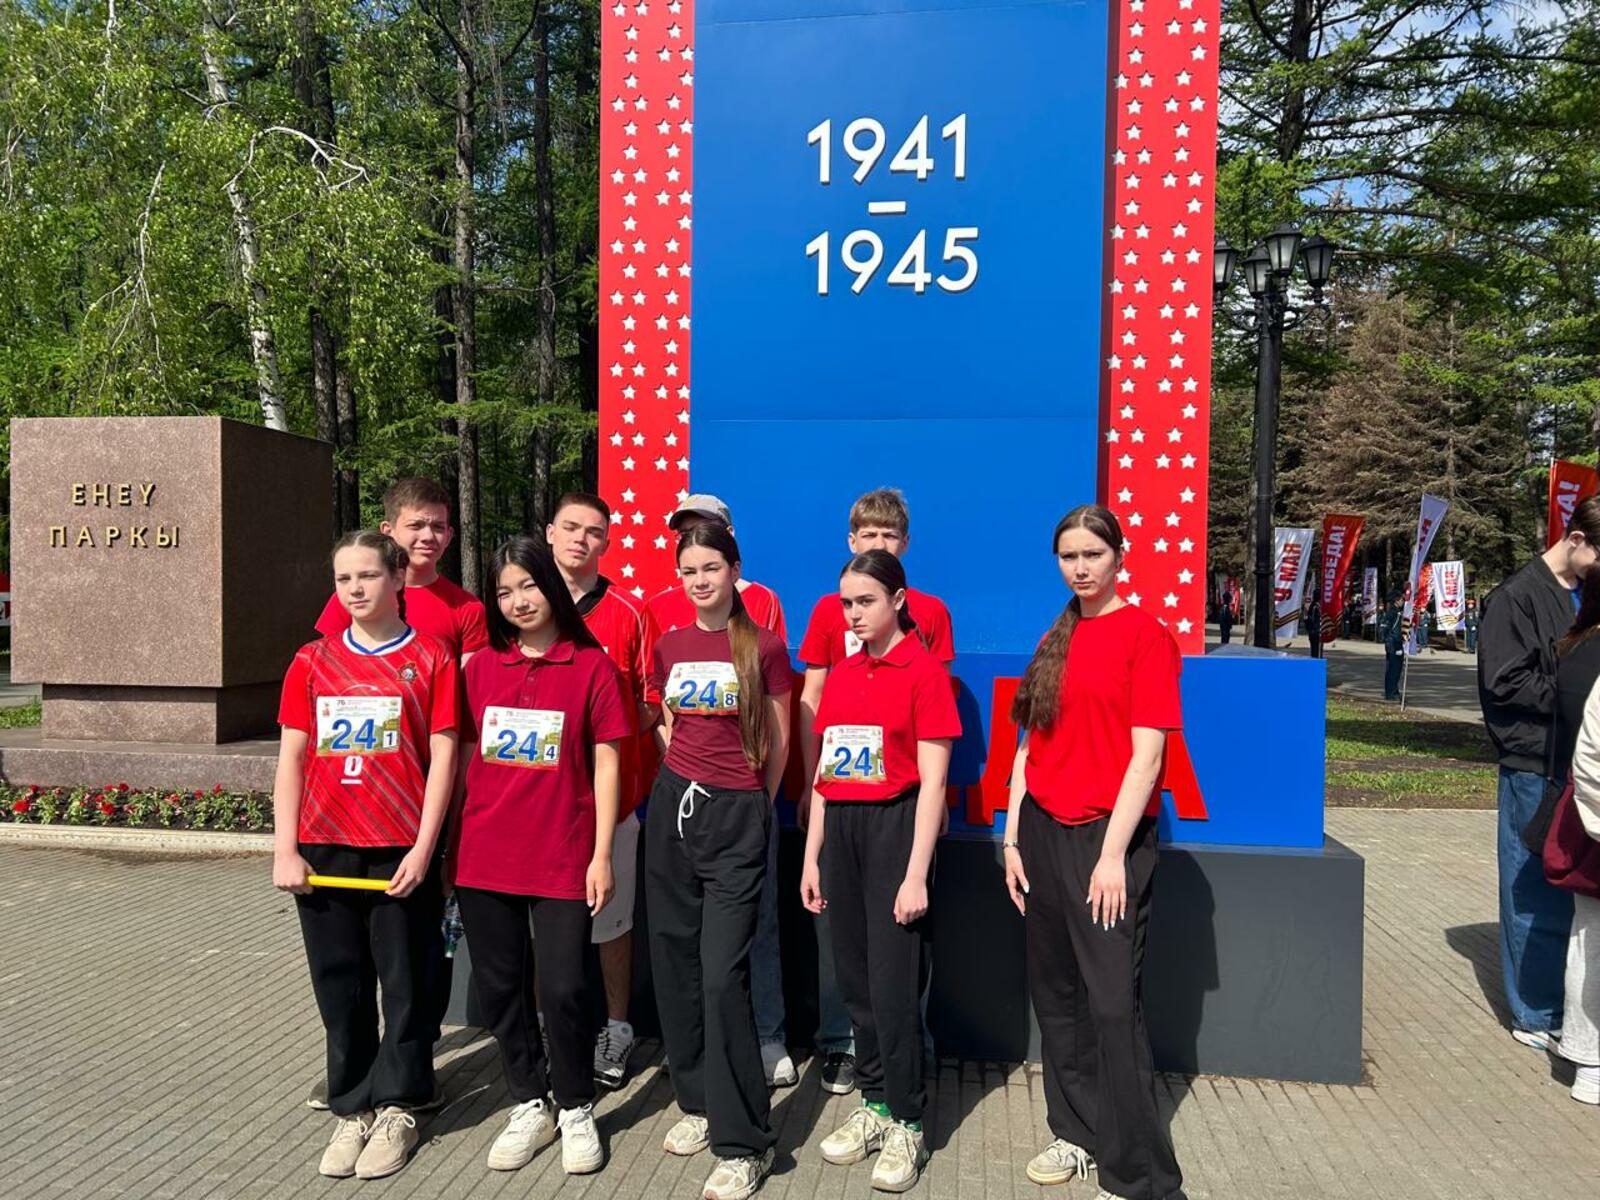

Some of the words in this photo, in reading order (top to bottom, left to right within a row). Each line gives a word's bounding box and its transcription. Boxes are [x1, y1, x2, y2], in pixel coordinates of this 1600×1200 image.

[807, 113, 967, 184] 1941
[805, 227, 979, 294] 1945
[50, 526, 179, 548] ПАРКЫ
[1279, 543, 1302, 582] МАЯ
[1323, 525, 1346, 603] ПОБЕДА!
[679, 680, 718, 708] 24
[725, 693, 735, 706] 8
[331, 719, 377, 750] 24
[386, 732, 393, 746] 1
[497, 729, 538, 762] 24
[546, 745, 556, 760] 4
[834, 746, 873, 777] 24
